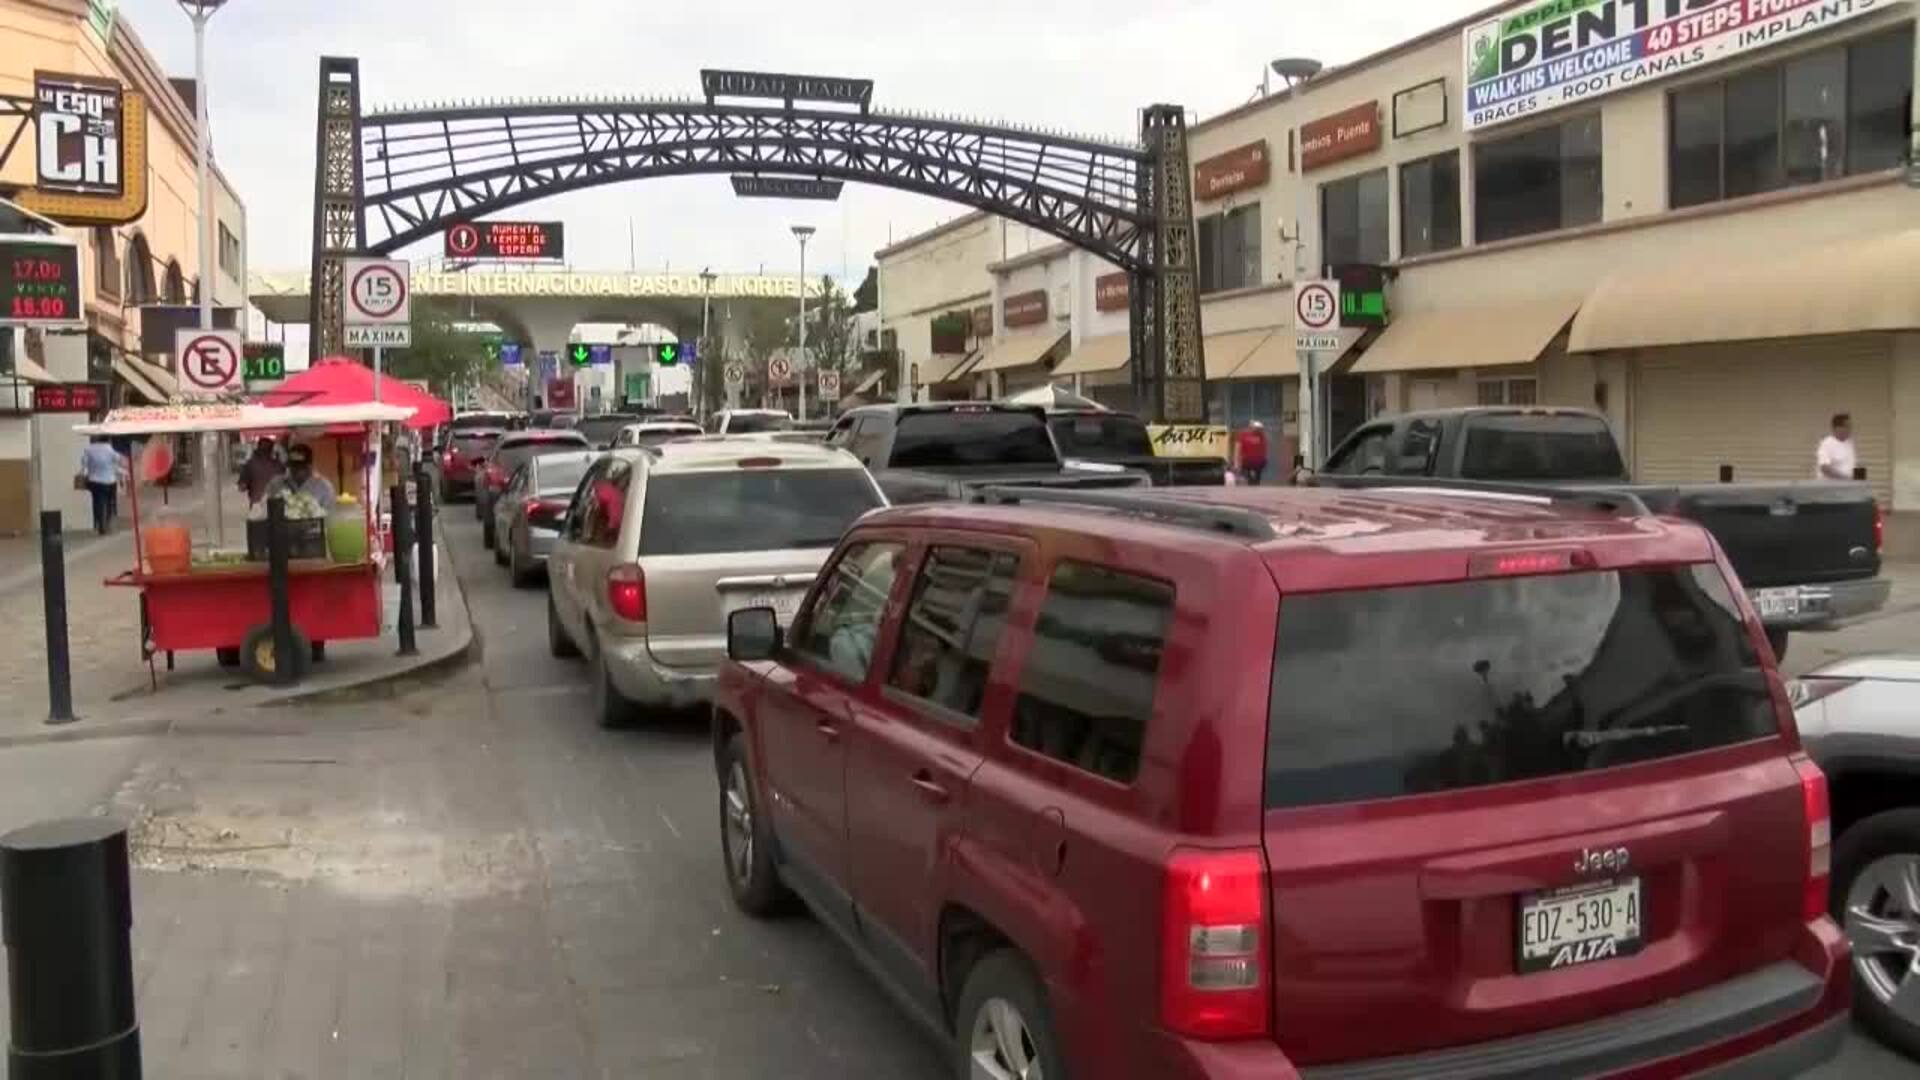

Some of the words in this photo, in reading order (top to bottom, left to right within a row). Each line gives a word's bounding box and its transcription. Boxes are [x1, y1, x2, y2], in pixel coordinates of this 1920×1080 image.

[1501, 0, 1718, 74] DENT
[1647, 28, 1673, 50] 40
[1677, 2, 1742, 43] STEPS
[1549, 39, 1632, 85] WELCOME
[1474, 97, 1538, 126] BRACES
[1562, 72, 1614, 100] ROOT
[1620, 46, 1705, 82] CANALS
[365, 277, 392, 296] 15
[462, 274, 623, 297] INTERNACIONAL
[629, 276, 681, 297] PASO
[731, 276, 793, 297] NORTE
[1307, 294, 1326, 312] 15
[1574, 846, 1630, 871] Jeep
[1525, 891, 1637, 945] EDZ-530-A
[1551, 936, 1617, 968] ALTA
